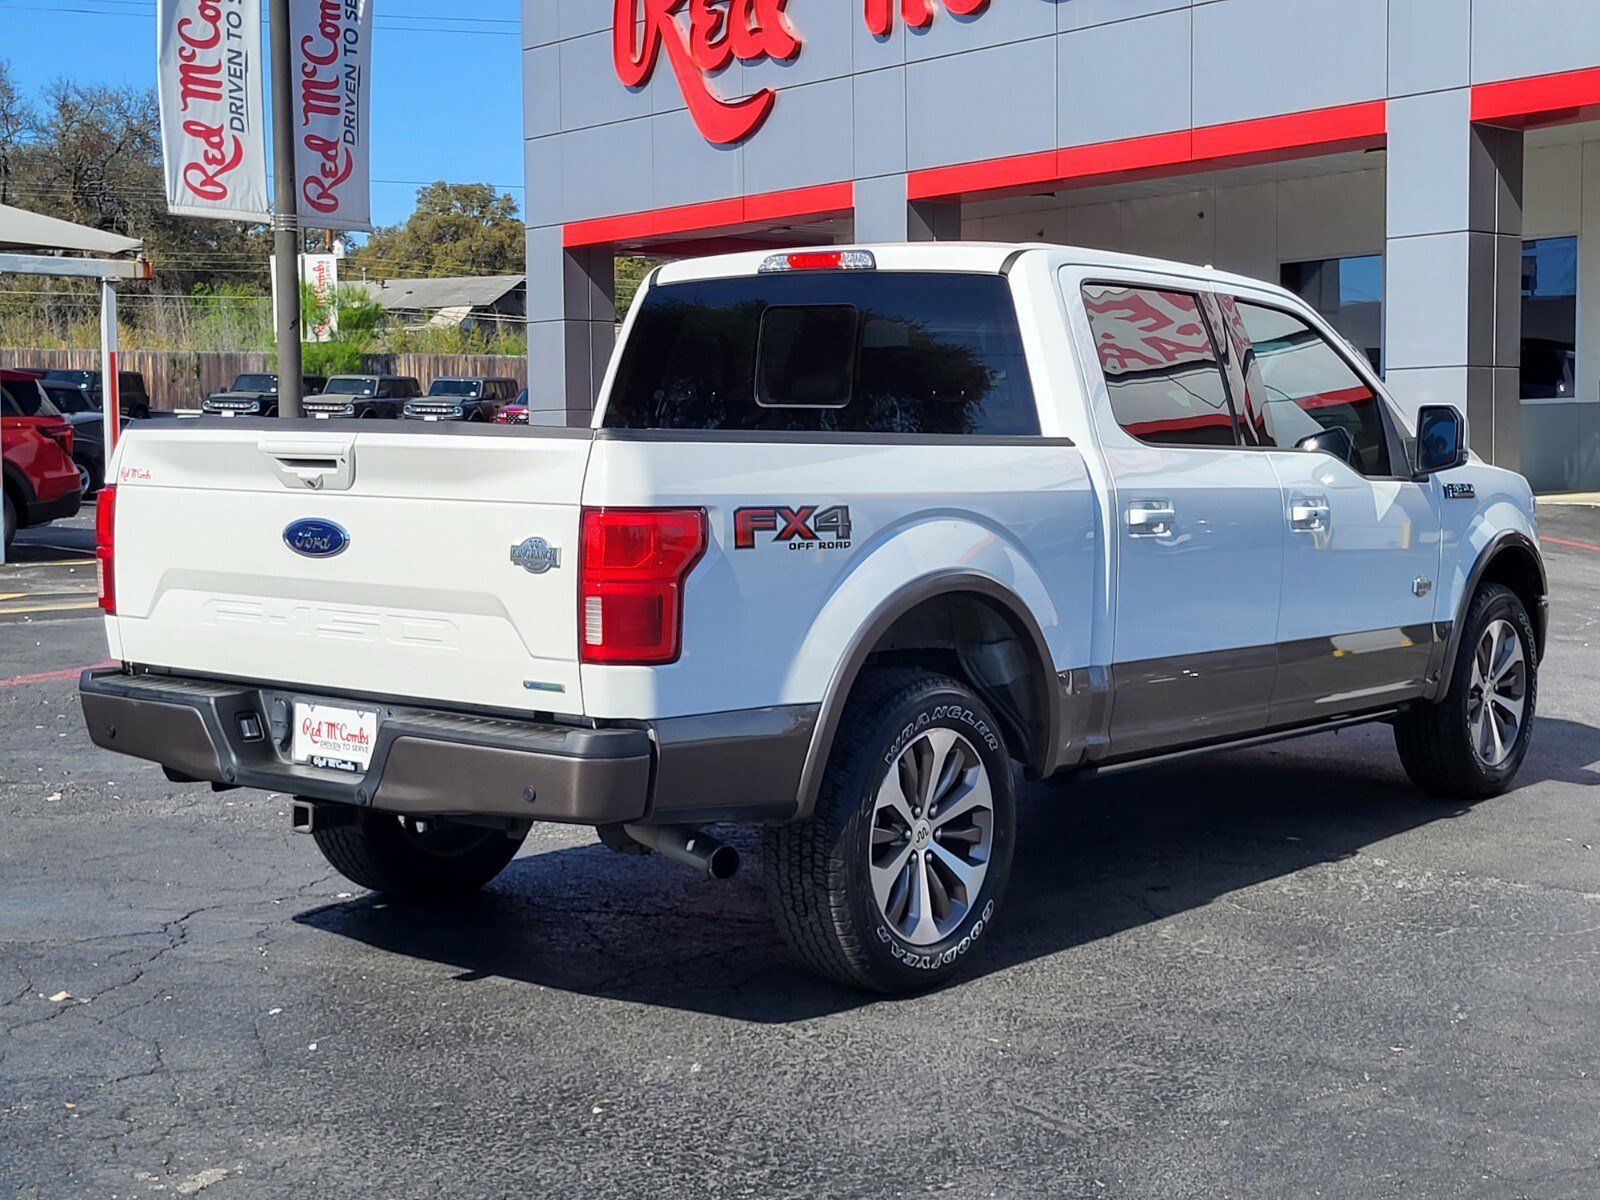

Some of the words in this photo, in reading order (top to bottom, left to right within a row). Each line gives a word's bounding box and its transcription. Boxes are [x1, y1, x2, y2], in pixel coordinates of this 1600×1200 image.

[226, 11, 242, 40] TO
[343, 28, 358, 57] TO
[226, 48, 245, 133] DRIVEN
[343, 64, 356, 145] DRIVEN
[183, 120, 243, 200] Red
[303, 134, 353, 214] Red
[294, 526, 331, 550] Ford
[733, 505, 852, 550] FX4
[788, 542, 815, 550] OFF
[818, 541, 851, 550] ROAD
[302, 717, 322, 744] Red
[320, 740, 341, 750] DRIVEN
[343, 743, 350, 751] TO
[352, 745, 369, 753] SERVE
[884, 705, 999, 765] WRANGLER
